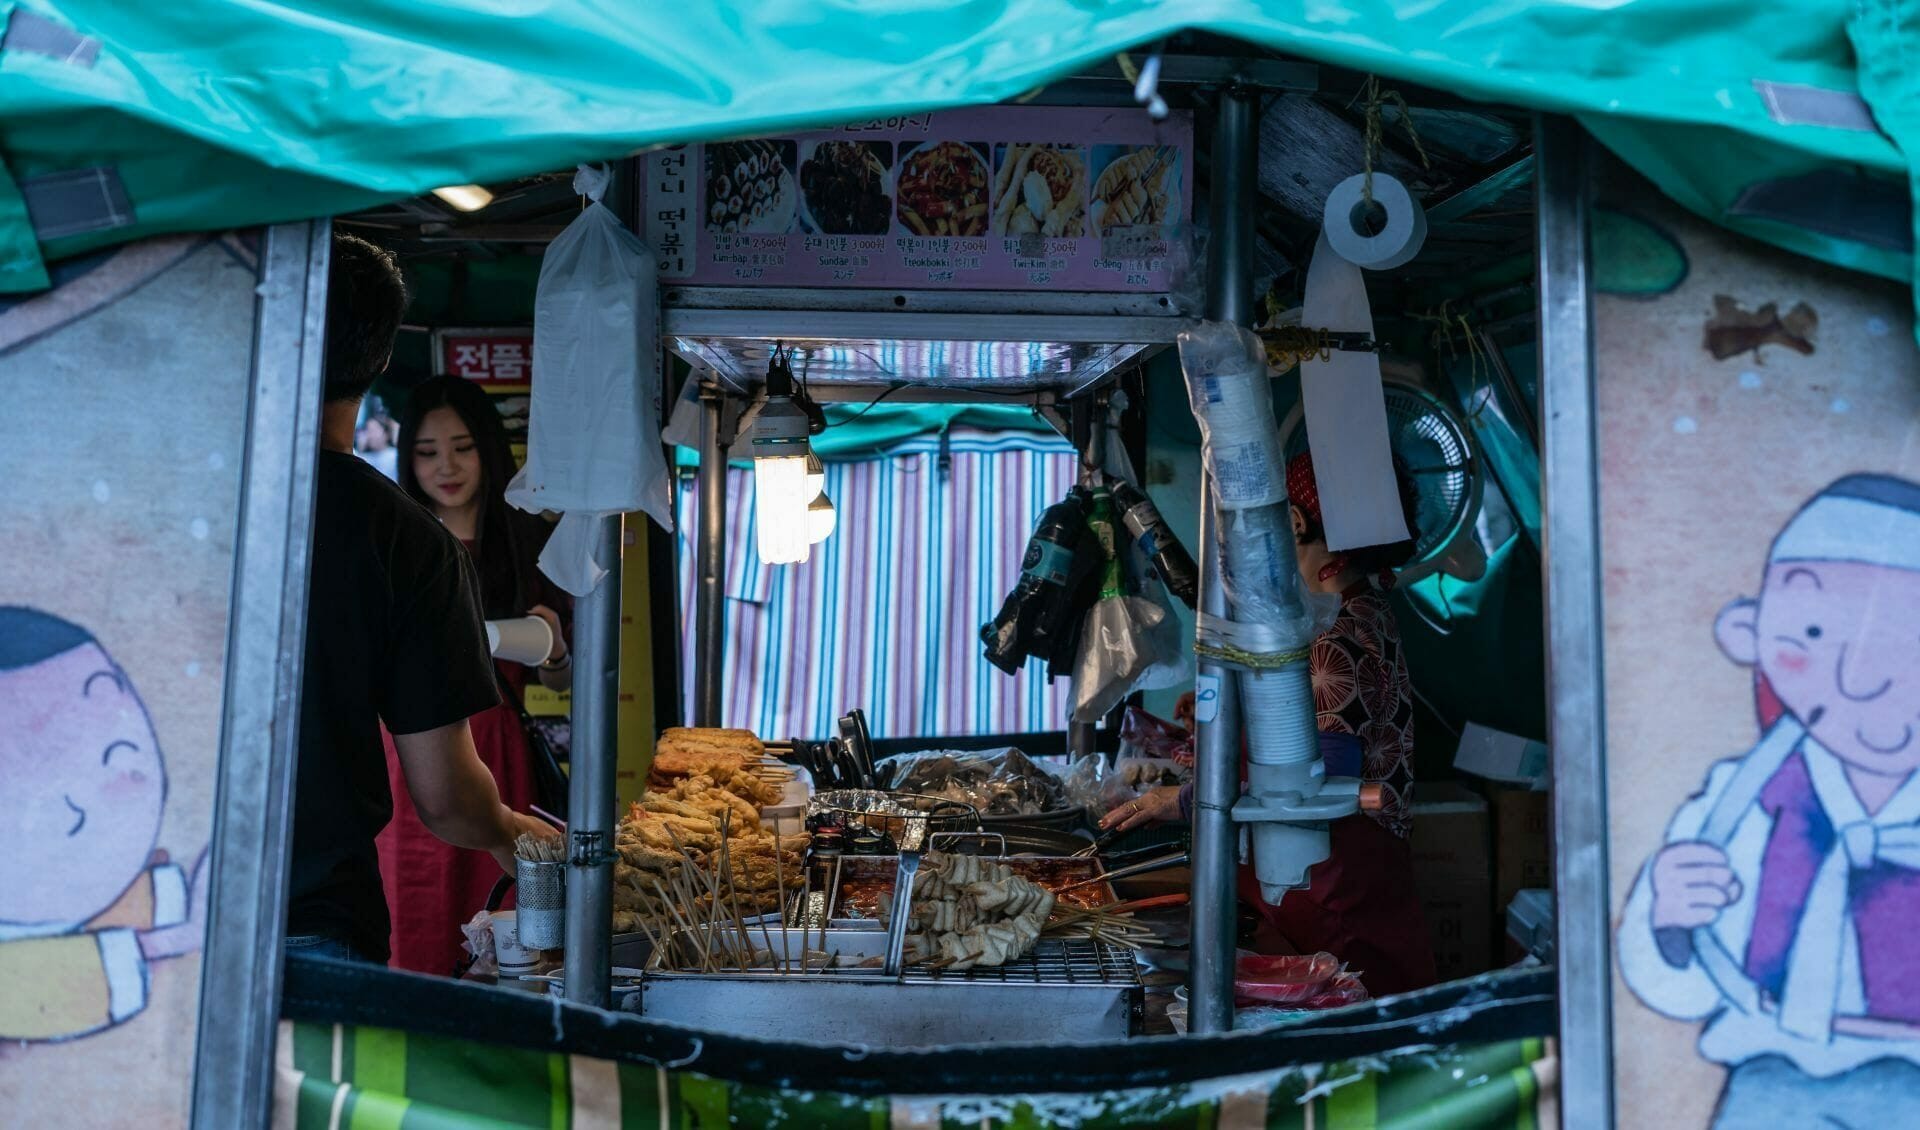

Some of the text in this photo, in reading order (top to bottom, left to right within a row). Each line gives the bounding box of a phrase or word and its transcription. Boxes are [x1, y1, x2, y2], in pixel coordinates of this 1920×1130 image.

[657, 153, 686, 272] 언니 떡볶이
[752, 235, 787, 251] 2,500원
[804, 236, 885, 252] 순대 1인분 3,000원
[896, 238, 924, 254] 떡볶이
[953, 239, 987, 255] 2,500원
[1043, 240, 1077, 256] 2,500원
[818, 255, 849, 266] Sundae
[903, 257, 950, 267] Tteokbokki
[1093, 258, 1122, 271] O-deng
[455, 343, 533, 379] 전품
